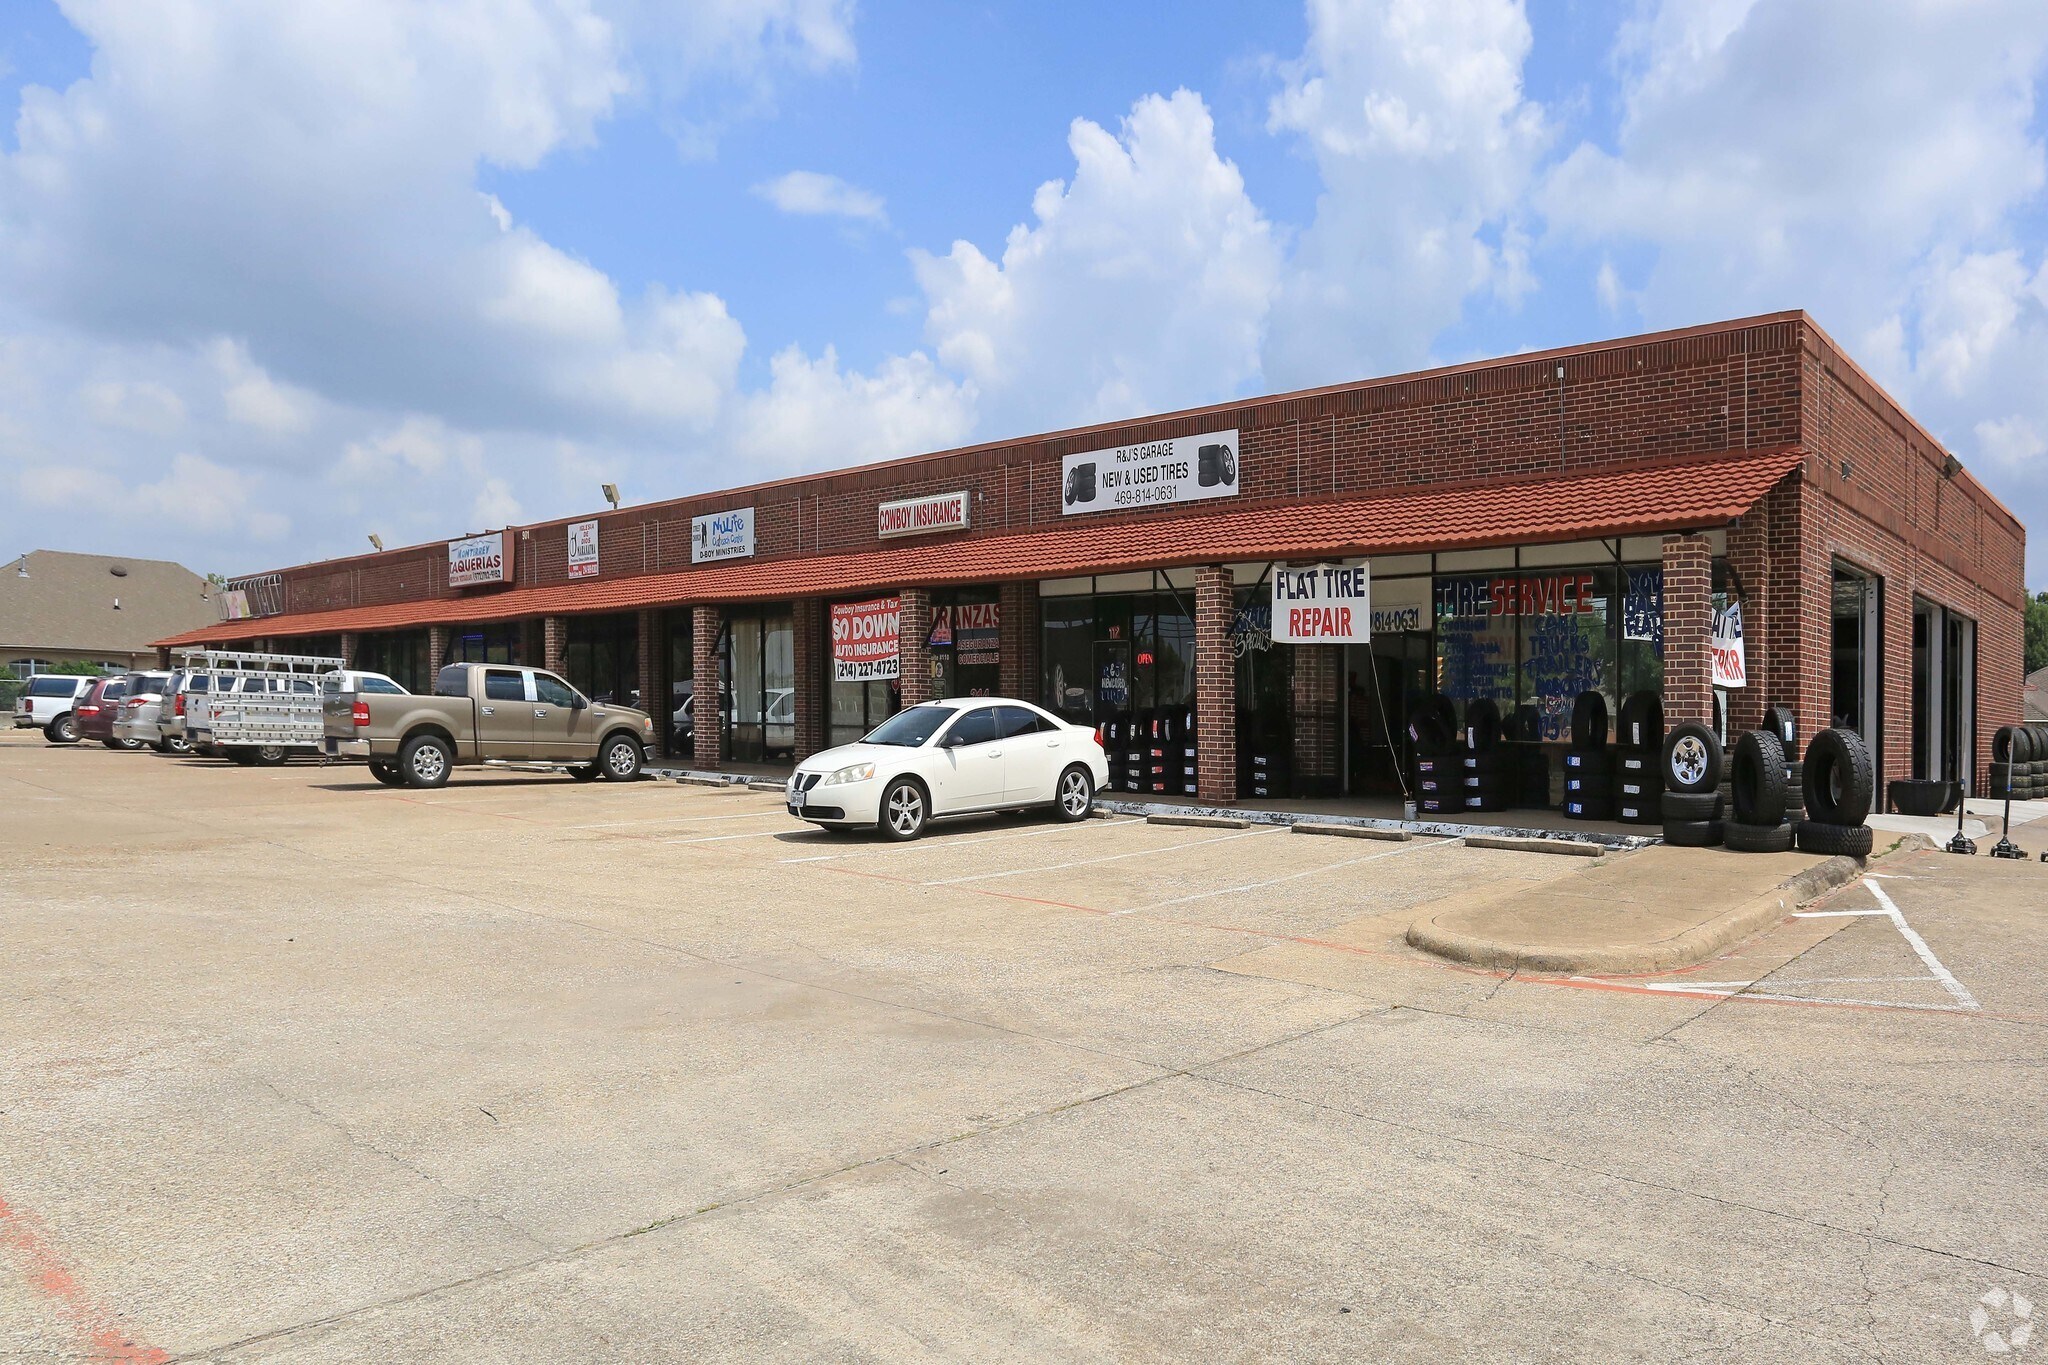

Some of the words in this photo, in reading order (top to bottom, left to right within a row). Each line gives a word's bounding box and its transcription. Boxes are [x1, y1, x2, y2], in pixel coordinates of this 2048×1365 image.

[1116, 447, 1138, 463] R&J'S
[1140, 442, 1174, 460] GARAGE
[1102, 471, 1123, 489] NEW
[1125, 471, 1131, 486] &
[1133, 465, 1159, 485] USED
[1160, 461, 1189, 481] TIRES
[1114, 484, 1178, 505] 469-814-0631
[879, 506, 912, 531] COWBOY
[913, 499, 961, 527] INSURANCE
[699, 549, 715, 559] D-BOY
[715, 545, 746, 557] MINISTRIES
[449, 554, 501, 574] TAQUERIAS
[1276, 569, 1319, 600] FLAT
[1323, 567, 1365, 599] TIRE
[1436, 579, 1488, 617] TIRE
[1488, 575, 1594, 616] SERVICE
[834, 605, 854, 615] Cowboy
[855, 602, 880, 612] Insurance
[881, 600, 885, 609] &
[887, 599, 899, 609] Tax
[852, 611, 900, 640] DOWN
[1108, 625, 1120, 639] 112
[1289, 607, 1353, 637] REPAIR
[1534, 614, 1579, 635] CARS
[835, 644, 853, 657] AUTO
[854, 639, 899, 656] INSURANCE
[1528, 634, 1590, 656] TRUCKS
[837, 662, 856, 680] (214)
[858, 658, 898, 677] 227-4723
[1137, 653, 1153, 665] OPEN
[1522, 654, 1604, 686] TRAILERS
